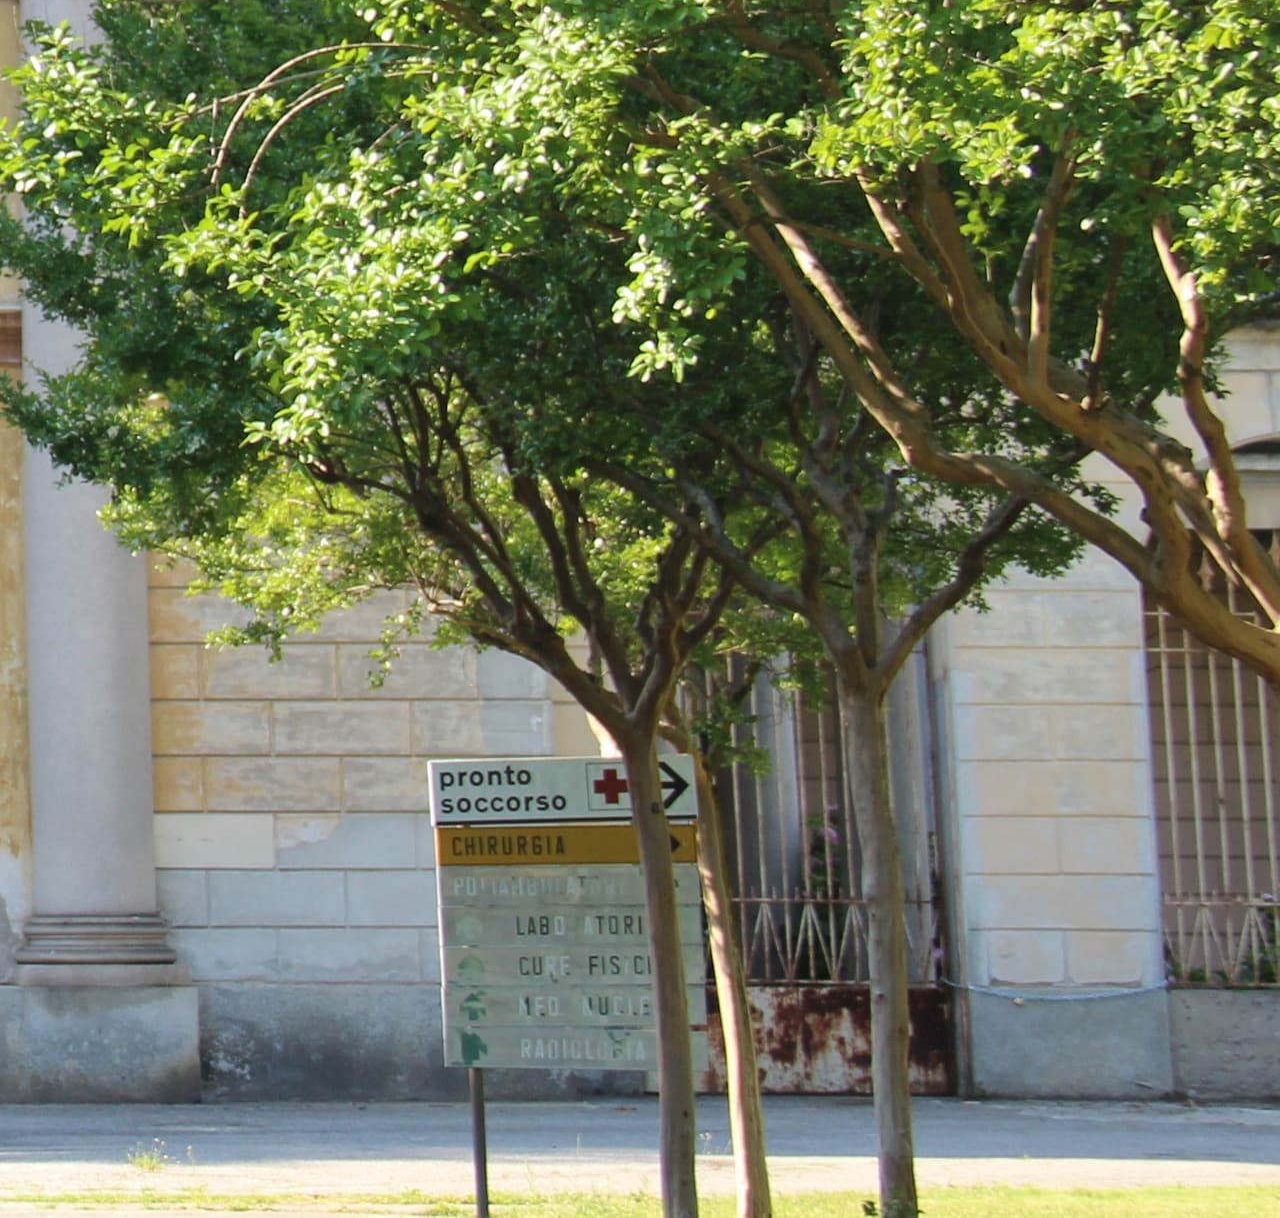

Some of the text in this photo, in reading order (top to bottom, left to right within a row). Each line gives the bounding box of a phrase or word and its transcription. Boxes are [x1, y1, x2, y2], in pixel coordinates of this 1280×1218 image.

[440, 765, 532, 791] pronto
[441, 794, 567, 814] soccorso
[451, 835, 566, 857] CHIRURGIA
[516, 915, 643, 935] LABOATORI
[582, 996, 650, 1016] NUCLE
